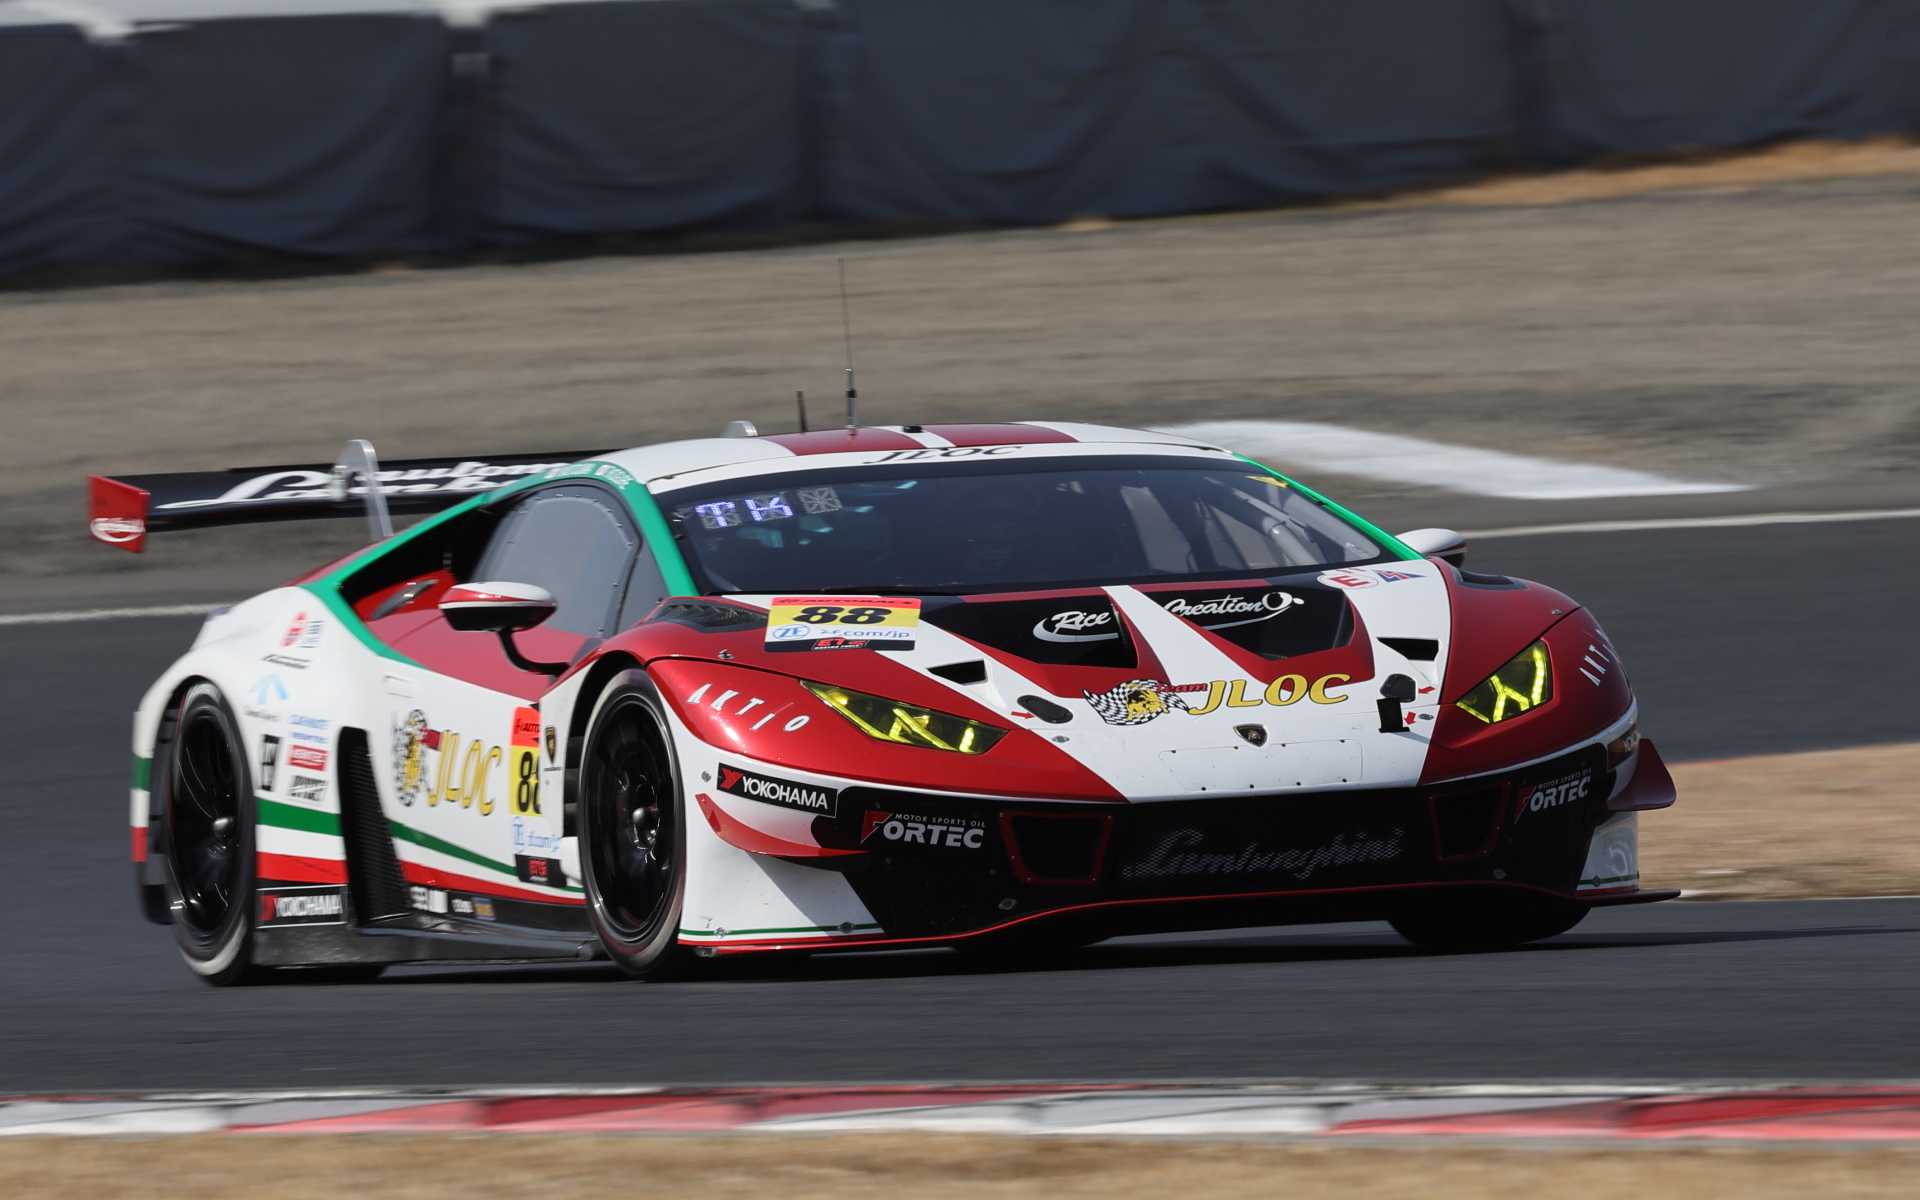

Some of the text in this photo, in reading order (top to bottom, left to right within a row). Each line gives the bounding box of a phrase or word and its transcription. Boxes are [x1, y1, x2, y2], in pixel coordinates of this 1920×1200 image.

[863, 445, 1024, 464] JLOC
[792, 606, 892, 625] 88
[1051, 611, 1112, 634] Rice
[1155, 682, 1208, 694] Team
[1188, 673, 1352, 716] JLOC
[427, 730, 502, 816] JLOC
[742, 776, 829, 810] YOKOHAMA
[895, 813, 986, 828] MOTOR SPORTS OIL
[1121, 826, 1404, 880] Lamborghini
